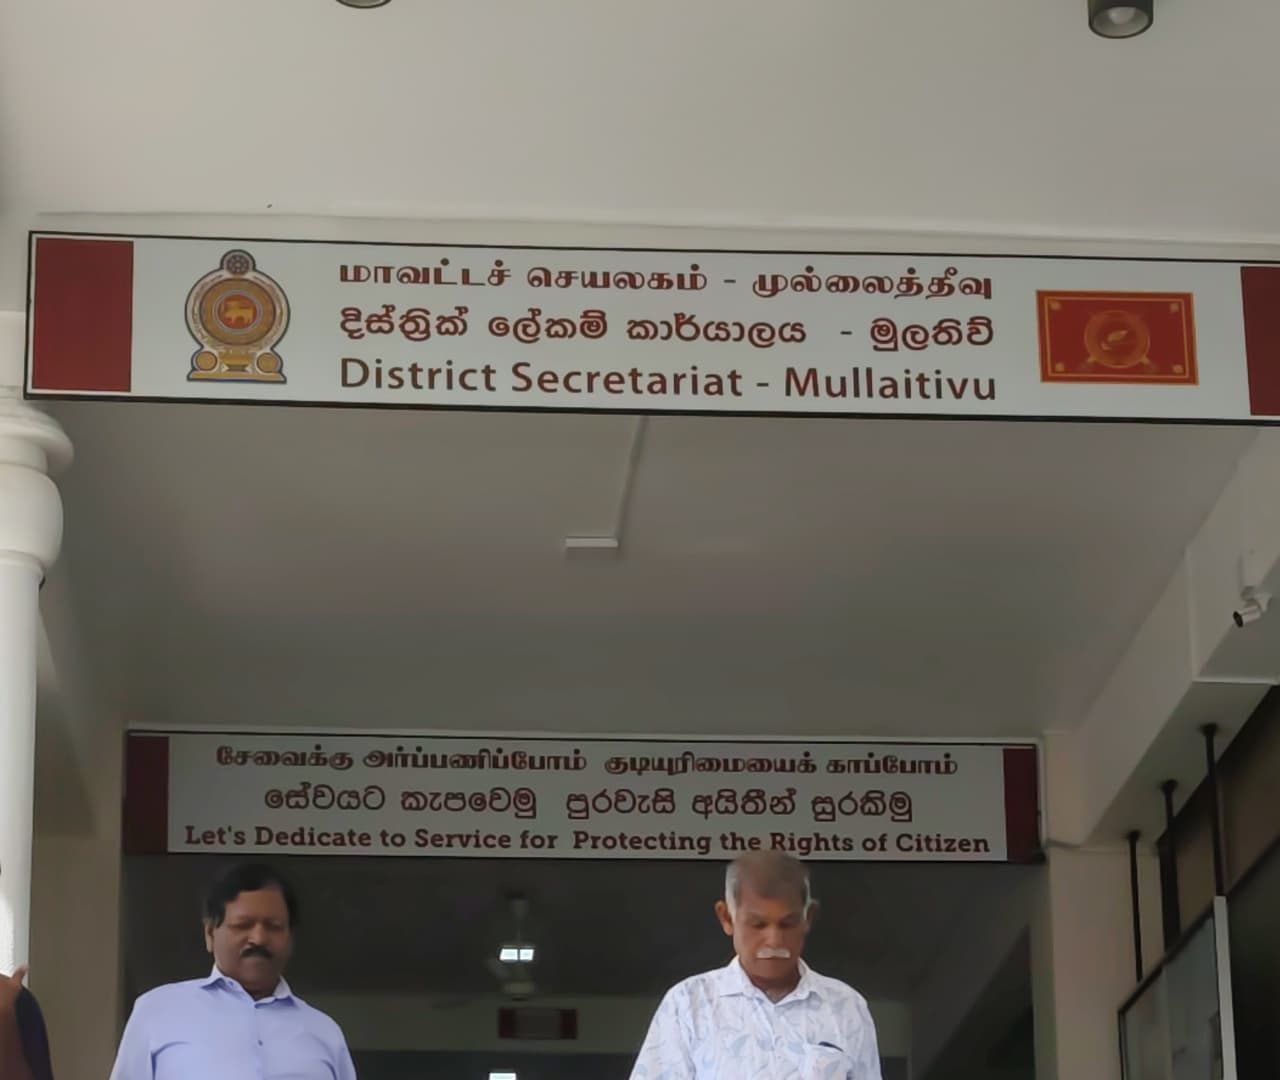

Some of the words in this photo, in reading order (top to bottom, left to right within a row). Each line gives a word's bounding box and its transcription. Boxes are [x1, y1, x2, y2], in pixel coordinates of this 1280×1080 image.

[339, 257, 512, 287] மாவட்டச்
[527, 263, 708, 291] செயலகம்
[752, 265, 992, 300] முல்லைத்தீவு
[341, 357, 497, 392] District
[511, 361, 743, 397] Secretariat
[785, 366, 996, 401] Mullaitivu
[216, 743, 354, 771] சேவைக்கு
[362, 745, 587, 771] அர்ப்பணிப்போம்
[604, 750, 818, 777] குடியுரிமையைக்
[826, 751, 958, 775] காப்போம்
[184, 825, 246, 846] Let's
[254, 825, 372, 847] Dedicate
[379, 829, 407, 848] to
[414, 828, 512, 849] Service
[519, 829, 559, 849] for
[572, 830, 712, 856] Protecting
[719, 831, 762, 851] the
[769, 832, 854, 855] Rights
[861, 832, 888, 852] of
[895, 833, 991, 853] Citizen
